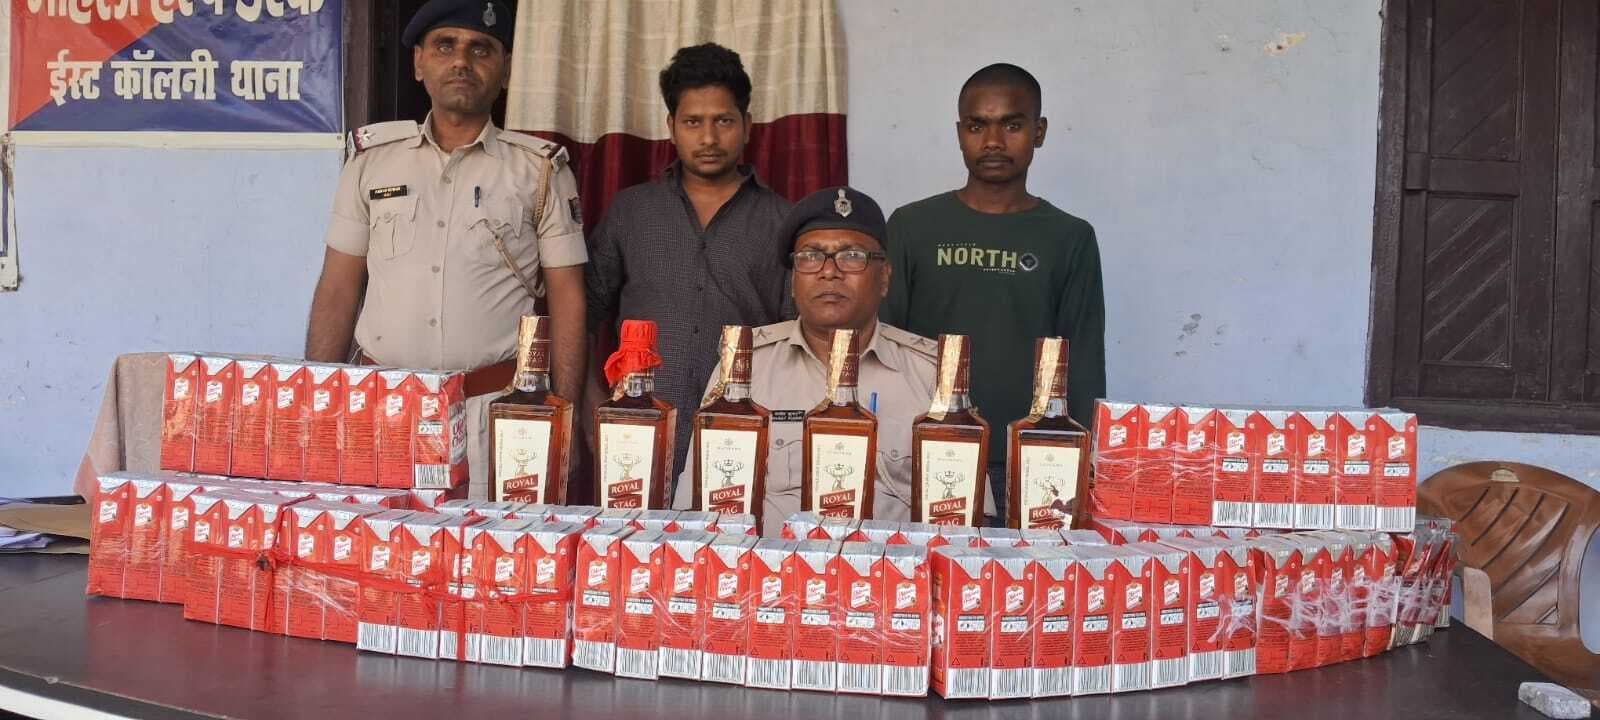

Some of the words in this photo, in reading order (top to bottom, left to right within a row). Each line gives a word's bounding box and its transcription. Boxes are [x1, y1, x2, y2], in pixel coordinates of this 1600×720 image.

[47, 49, 103, 106] ईस्ट
[110, 49, 219, 100] कॉलनी
[231, 60, 303, 100] थाना
[937, 247, 1017, 268] NORTH
[506, 477, 534, 490] ROYAL
[611, 482, 639, 494] ROYAL
[712, 488, 742, 501] ROYAL
[823, 493, 852, 505] ROYAL
[933, 500, 962, 512] ROYAL
